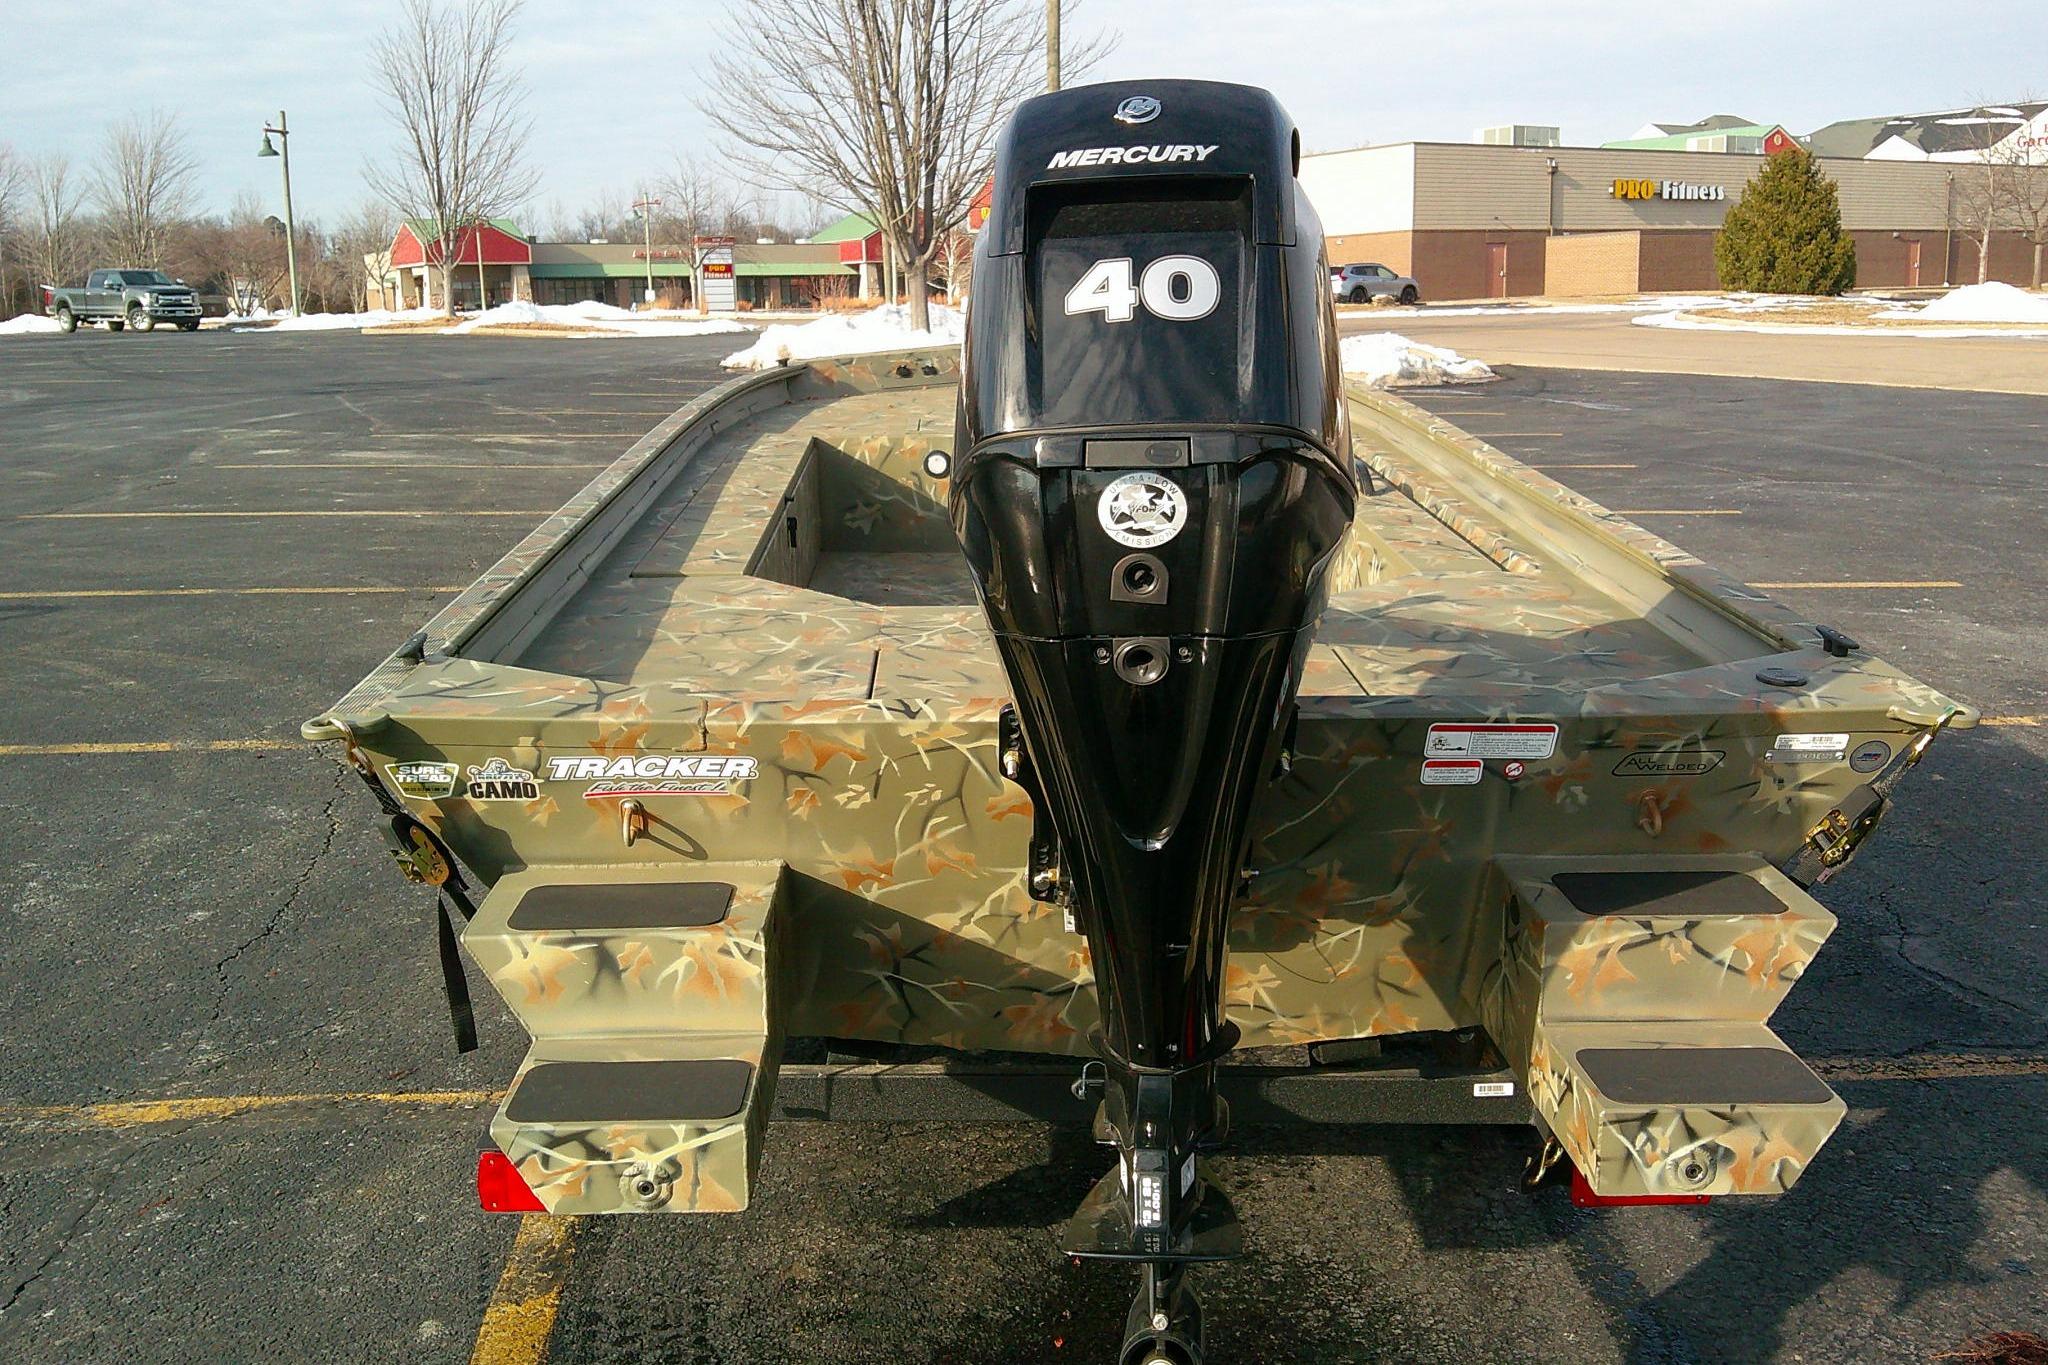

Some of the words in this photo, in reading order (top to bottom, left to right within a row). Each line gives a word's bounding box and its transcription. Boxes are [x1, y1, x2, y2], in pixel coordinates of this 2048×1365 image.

[1046, 145, 1220, 170] MERCURY
[1614, 179, 1655, 200] PRO
[1661, 180, 1725, 200] Fitness
[1065, 254, 1221, 323] 40
[398, 765, 446, 775] SURE
[549, 757, 756, 778] TRACKER
[1624, 757, 1657, 768] ALL
[1637, 763, 1707, 771] WELDED
[395, 774, 452, 783] TREAD
[470, 782, 537, 799] CAMO
